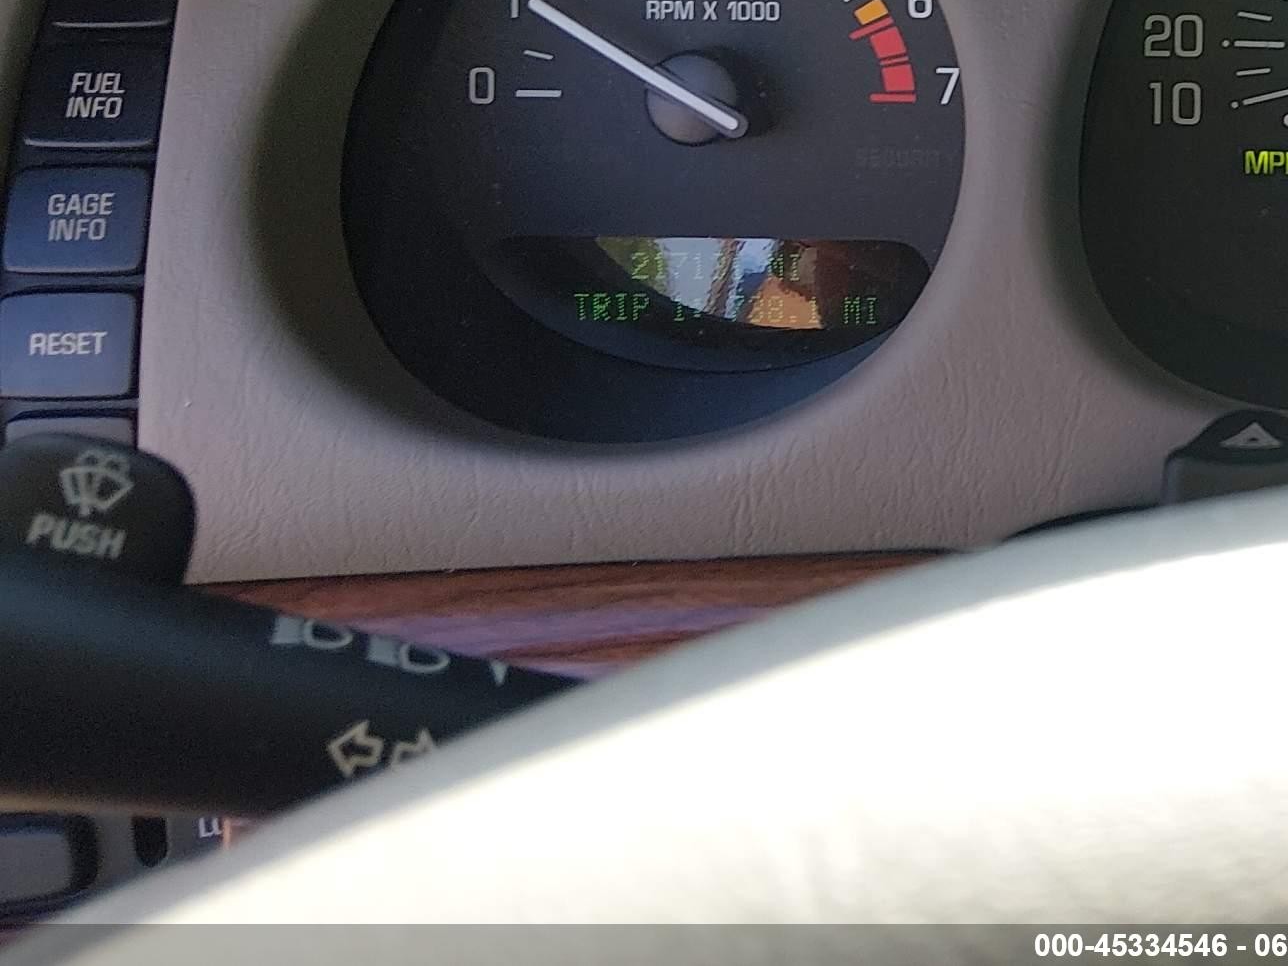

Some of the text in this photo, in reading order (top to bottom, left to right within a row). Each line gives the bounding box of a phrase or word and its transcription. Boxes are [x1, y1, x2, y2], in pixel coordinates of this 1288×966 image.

[647, 1, 779, 20] RPM X 1000
[1145, 15, 1203, 57] 20
[71, 73, 124, 94] FUEL
[470, 68, 494, 104] 0
[936, 68, 961, 104] 7
[66, 97, 122, 118] INFO
[1150, 83, 1200, 124] 10
[48, 193, 114, 215] GAGE
[48, 219, 105, 241] INFO
[573, 292, 650, 322] TRIP
[841, 295, 878, 324] MI
[30, 332, 107, 355] RESET
[27, 510, 124, 557] PUSH
